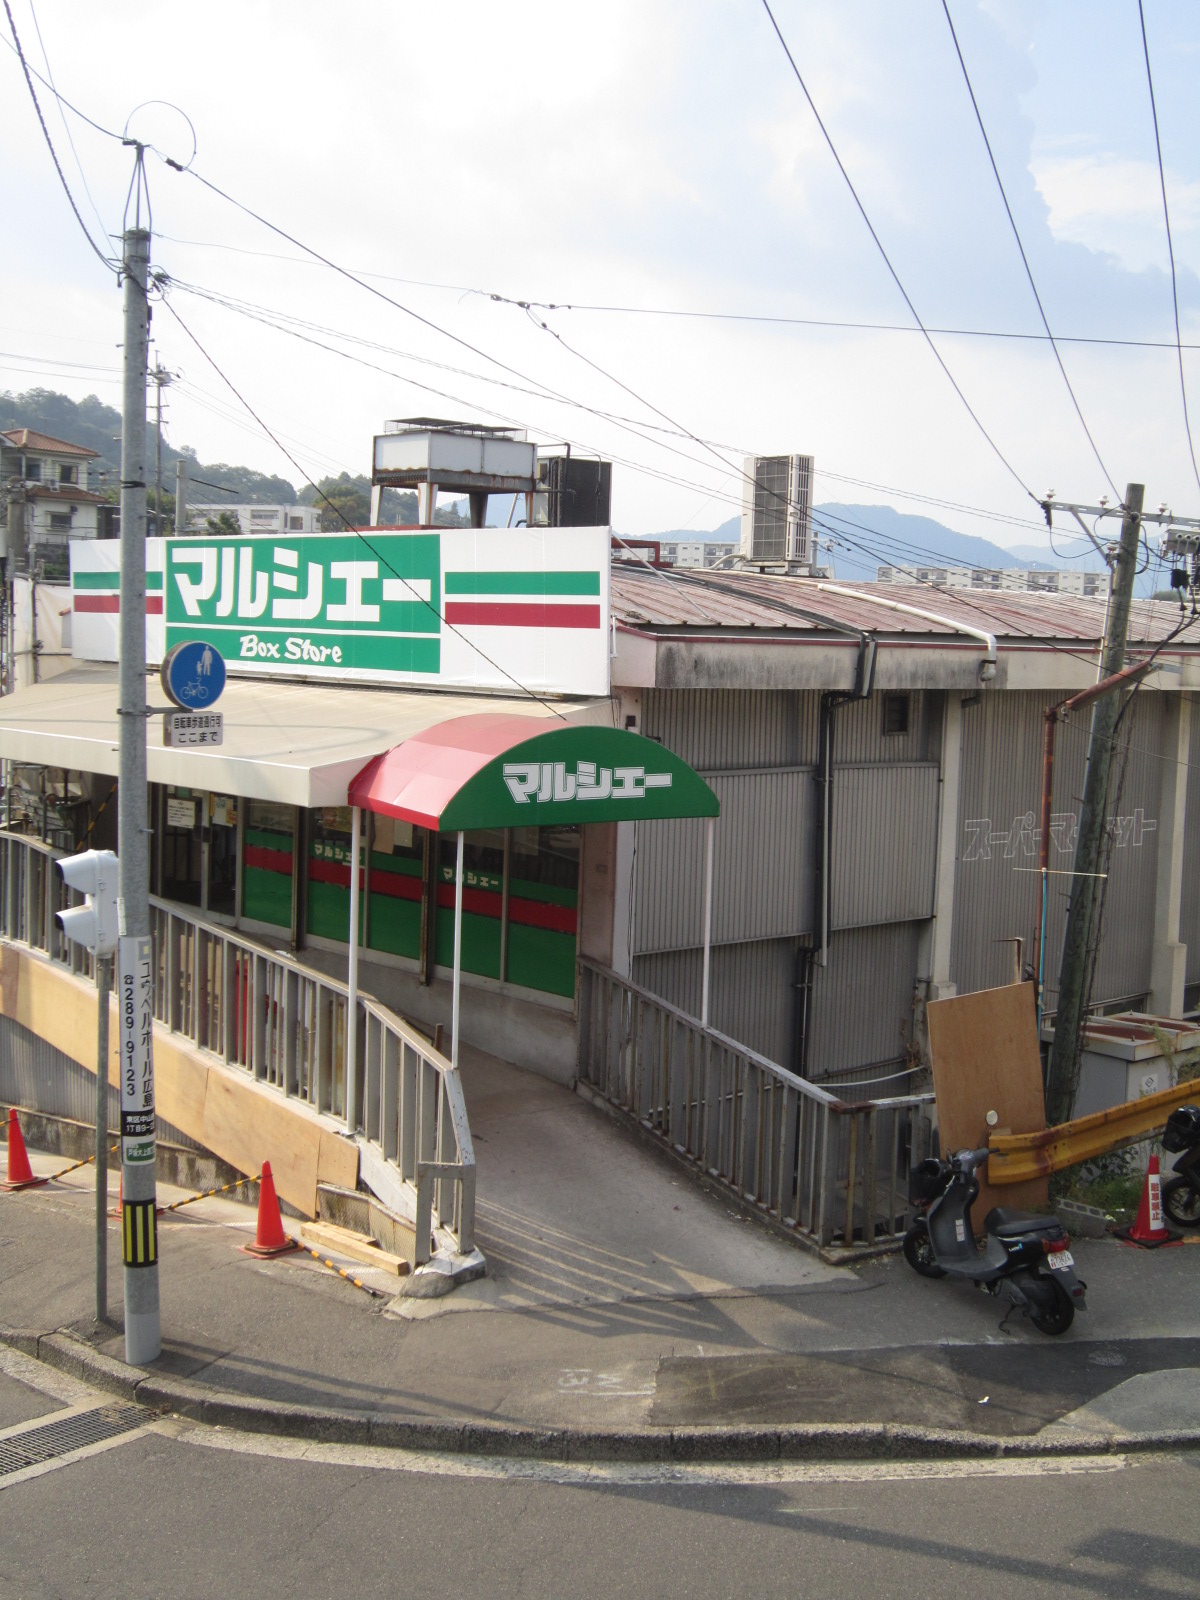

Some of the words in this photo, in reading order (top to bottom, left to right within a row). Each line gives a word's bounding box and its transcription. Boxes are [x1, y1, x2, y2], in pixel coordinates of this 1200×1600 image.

[239, 634, 281, 659] Box
[284, 637, 343, 663] Store
[174, 715, 222, 729] 自転車歩道通行可
[178, 731, 218, 743] ここまで
